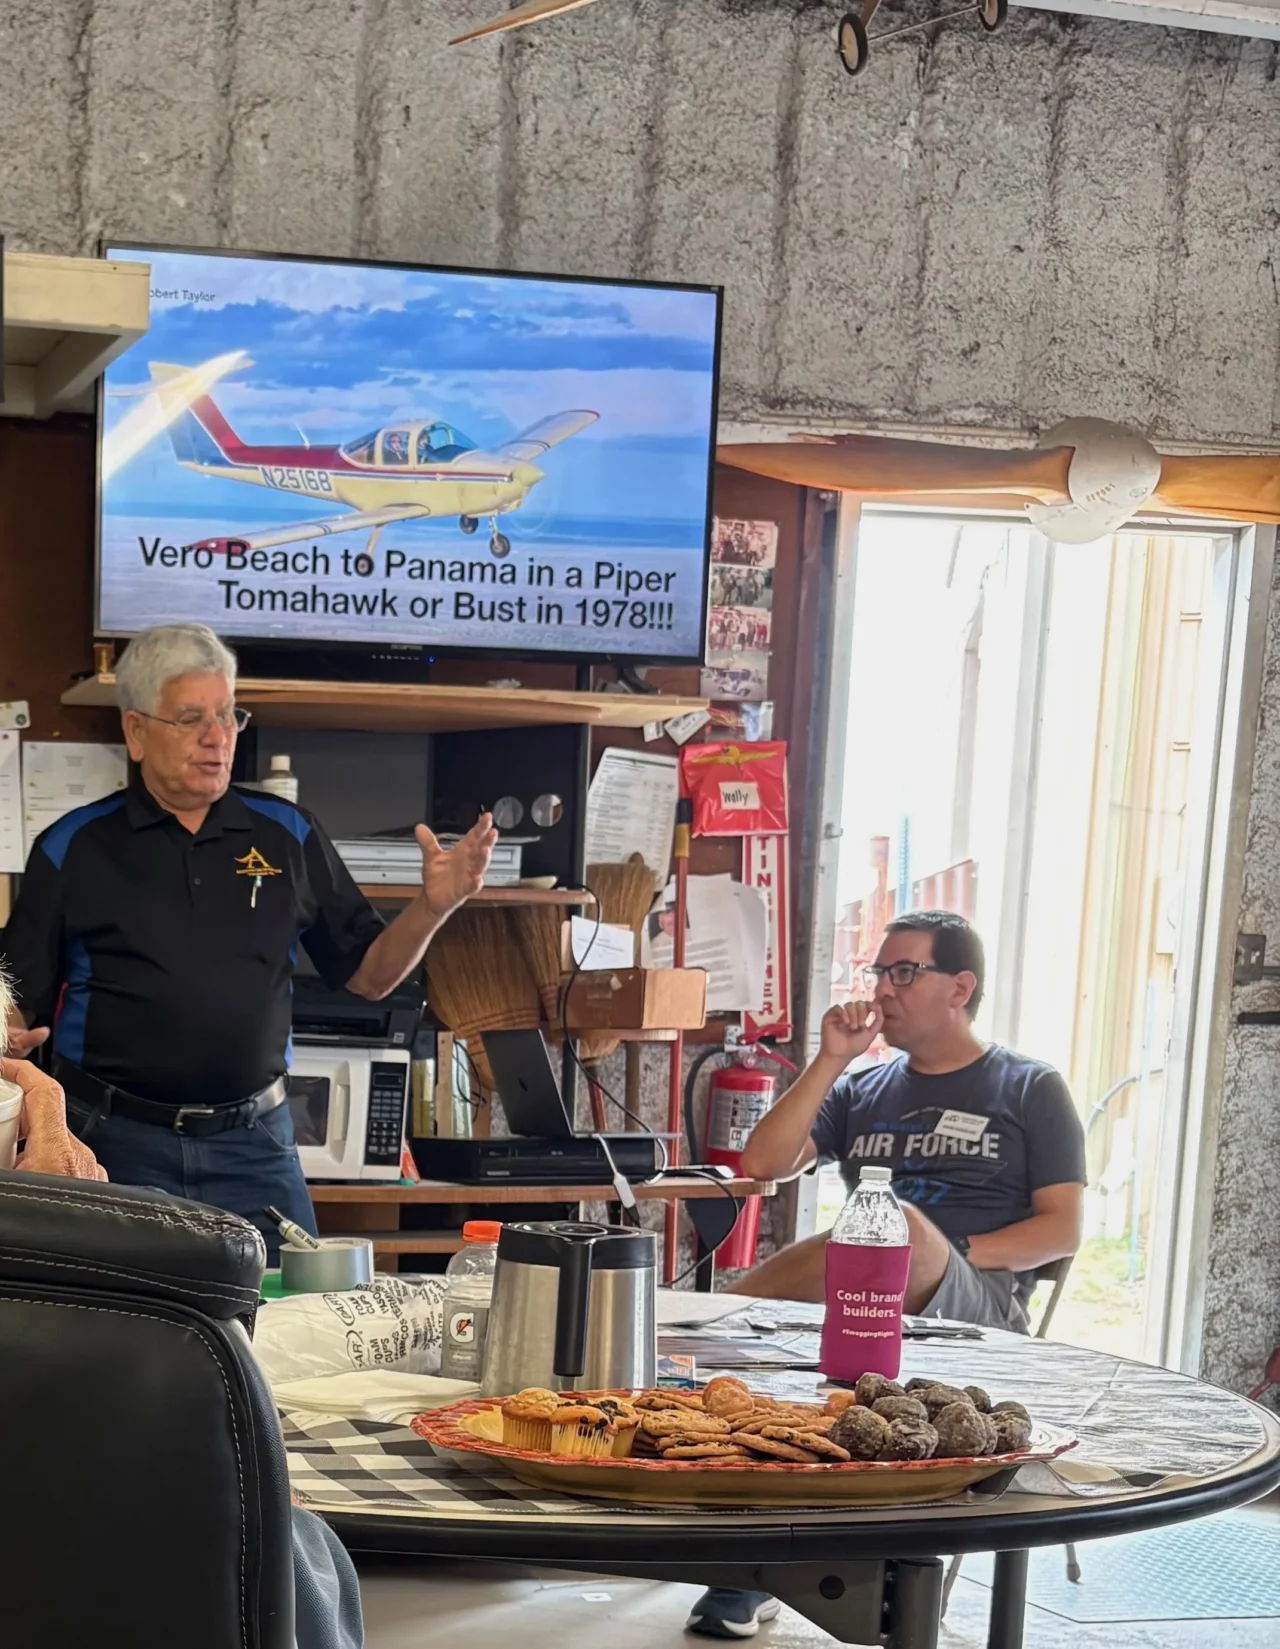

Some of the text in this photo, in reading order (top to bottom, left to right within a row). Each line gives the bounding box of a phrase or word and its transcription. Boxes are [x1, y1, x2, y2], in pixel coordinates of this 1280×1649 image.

[149, 288, 216, 303] obert Taylor
[138, 536, 676, 598] Vero Beach to Panama in a Piper
[218, 579, 673, 631] Tomahawk or Bust in 1978!!!
[847, 1132, 1000, 1159] AIR FORCE
[836, 1289, 904, 1303] Cool brand
[843, 1304, 897, 1318] builders.
[450, 1312, 474, 1342] G
